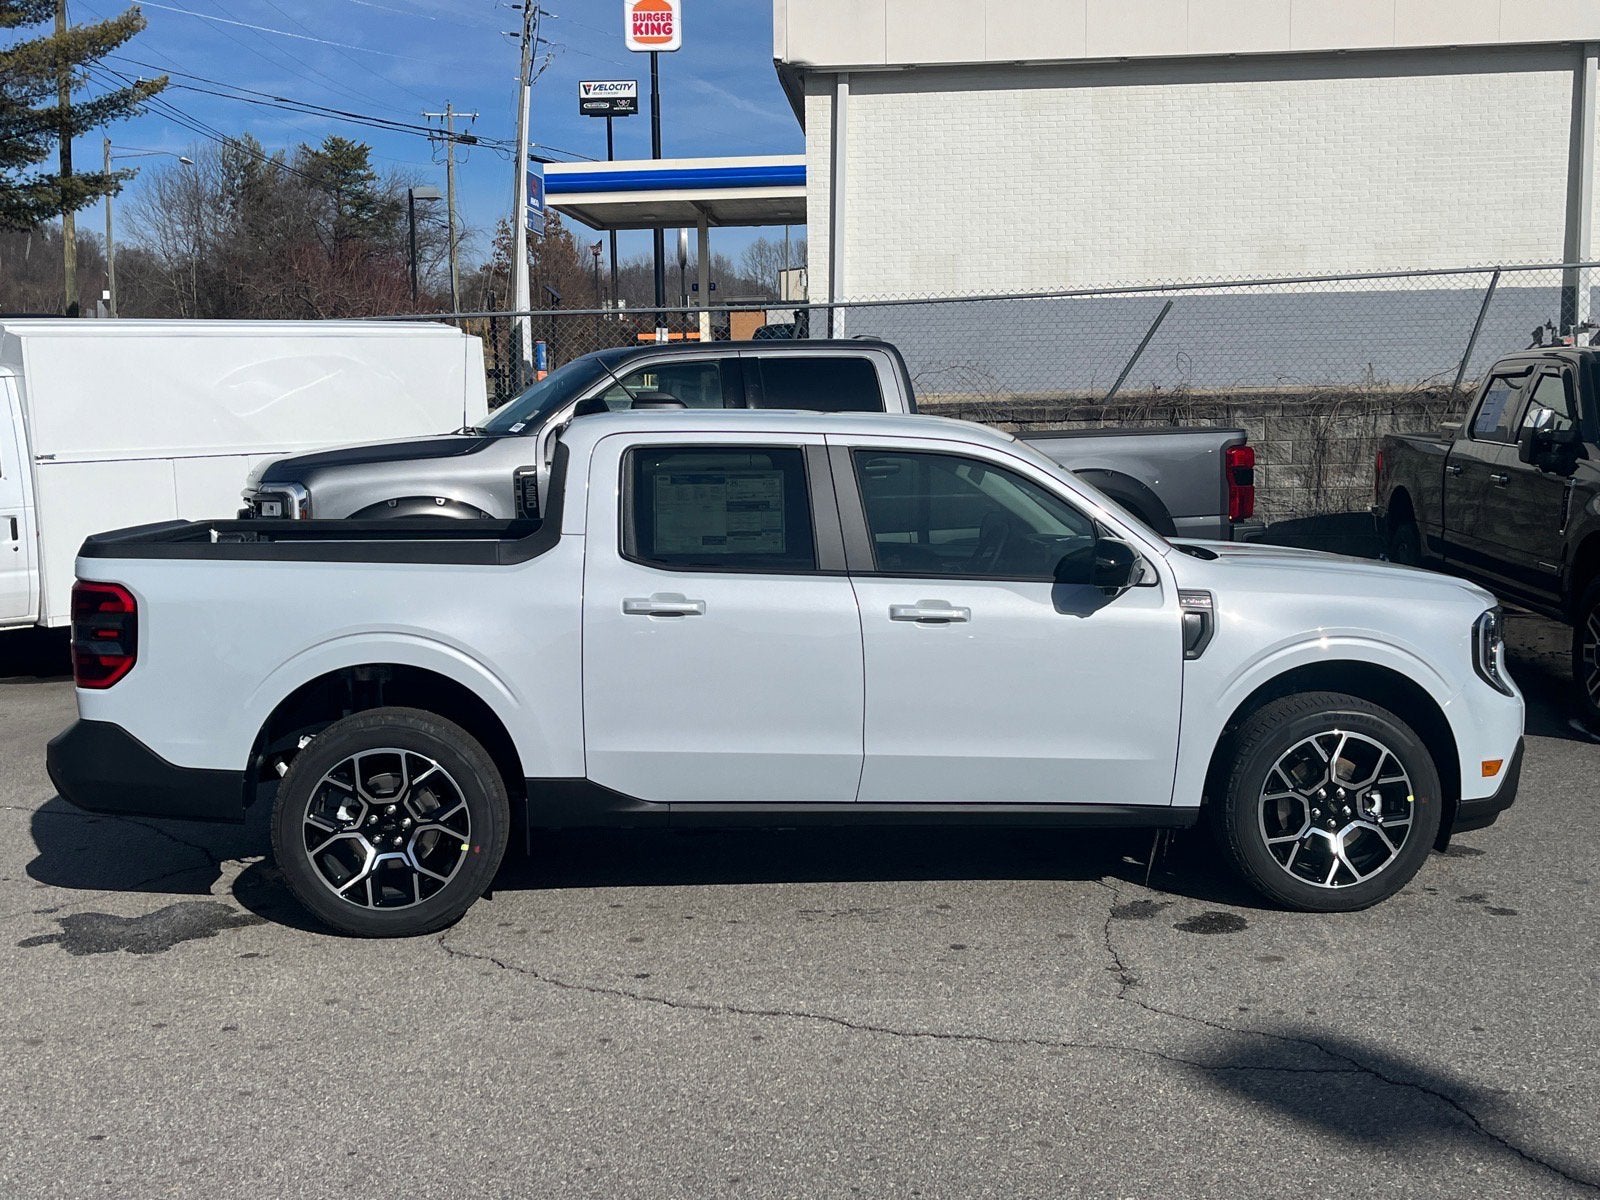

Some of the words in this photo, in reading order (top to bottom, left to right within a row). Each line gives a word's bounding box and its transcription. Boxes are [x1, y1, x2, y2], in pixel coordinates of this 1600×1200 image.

[632, 12, 673, 22] BURGER
[632, 22, 673, 36] KING
[593, 83, 634, 92] VELOCITY
